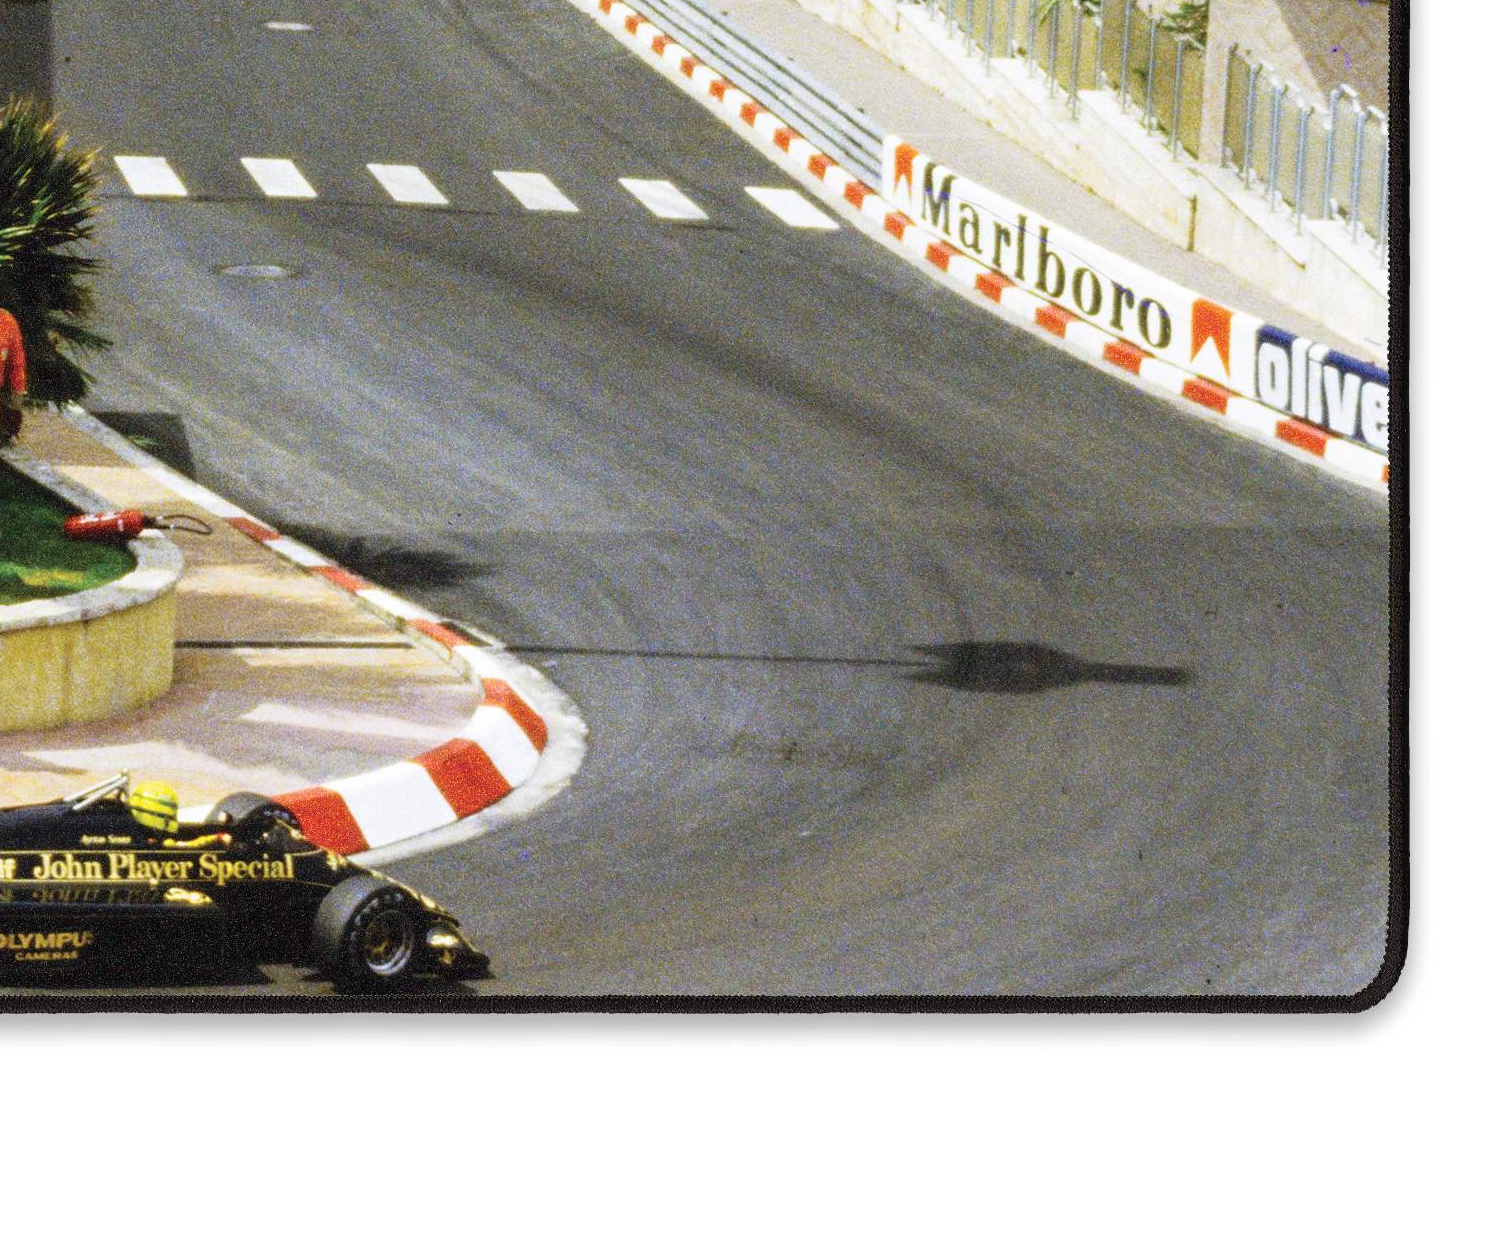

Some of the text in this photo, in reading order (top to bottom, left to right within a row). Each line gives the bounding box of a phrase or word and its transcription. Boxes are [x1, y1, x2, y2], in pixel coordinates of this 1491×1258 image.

[921, 162, 1172, 350] Marlboro
[33, 853, 102, 881] John
[109, 853, 195, 886] Player
[199, 853, 296, 887] Special
